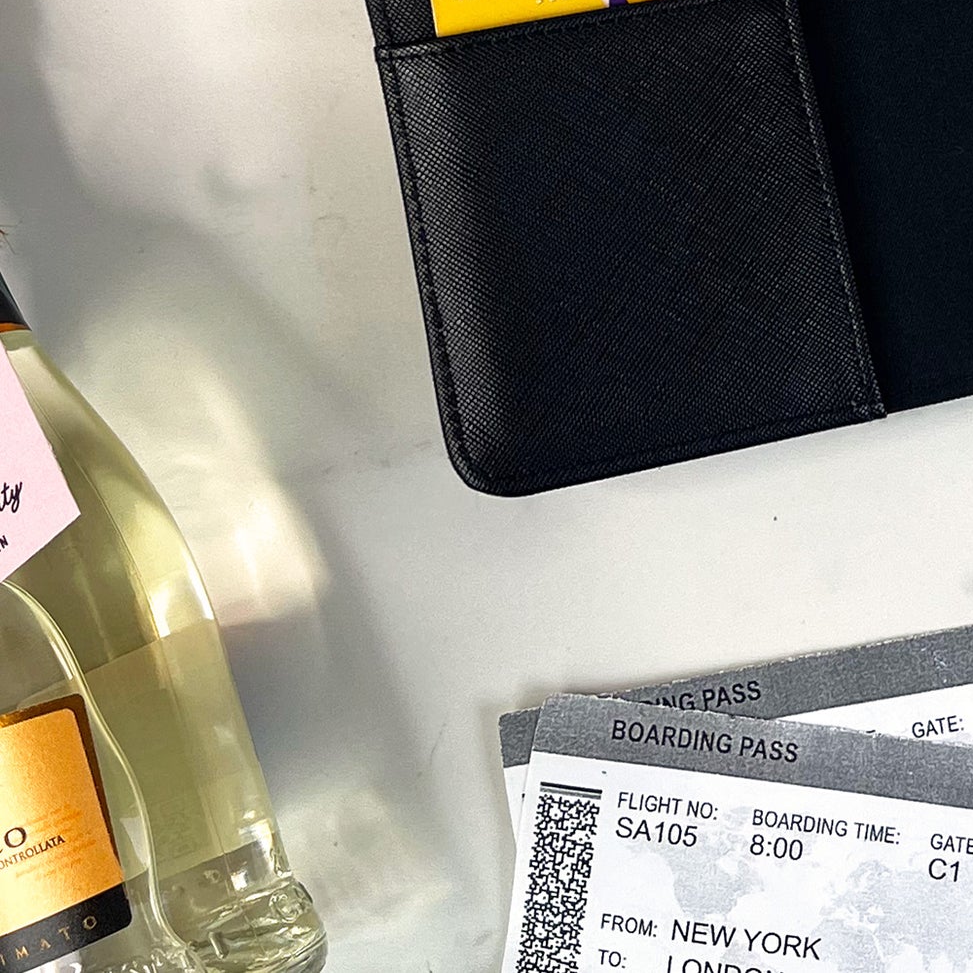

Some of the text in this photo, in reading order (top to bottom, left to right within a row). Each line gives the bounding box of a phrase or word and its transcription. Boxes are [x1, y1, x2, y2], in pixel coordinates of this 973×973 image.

[702, 680, 762, 712] PASS
[611, 719, 799, 763] BOARDING PASS
[912, 715, 965, 738] GATE:
[617, 792, 719, 821] FLIGHT NO:
[0, 827, 27, 854] O
[615, 816, 698, 847] SA105
[752, 809, 901, 845] BOARDING TIME:
[750, 834, 804, 861] 8:00
[928, 858, 960, 883] C1
[600, 913, 822, 961] FROM: NEW YORK
[598, 948, 627, 969] TO:
